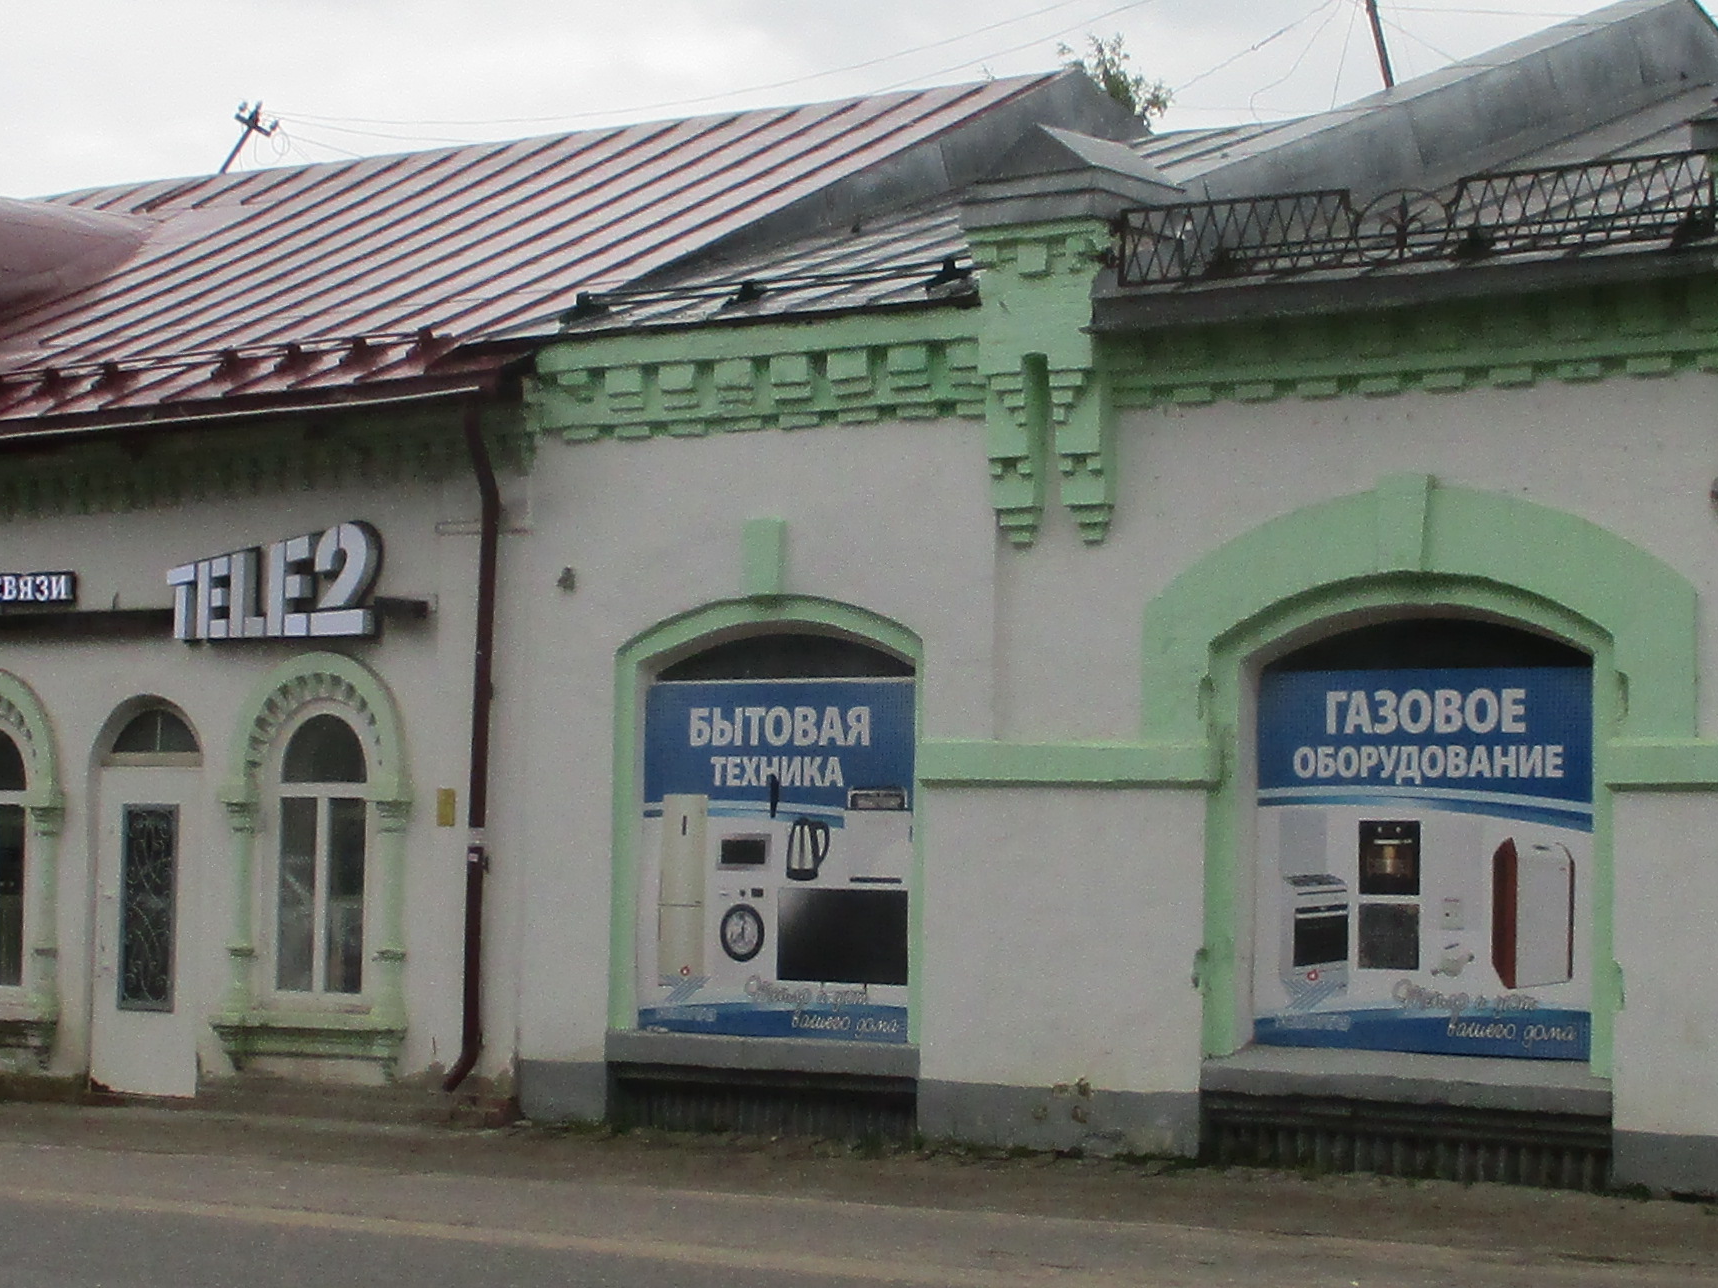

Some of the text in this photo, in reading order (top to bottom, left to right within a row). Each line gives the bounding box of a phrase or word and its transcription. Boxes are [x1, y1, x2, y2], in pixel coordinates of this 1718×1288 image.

[167, 519, 382, 641] TELE2
[689, 705, 871, 747] БЫТОВАЯ
[1324, 687, 1528, 734] ГАЗОВОЕ
[710, 755, 844, 787] ТЕХНИКА
[1293, 745, 1564, 785] ОБОРУДОВАНИЕ
[790, 1010, 900, 1039] вашего дома
[1446, 1016, 1576, 1048] вашего дома
